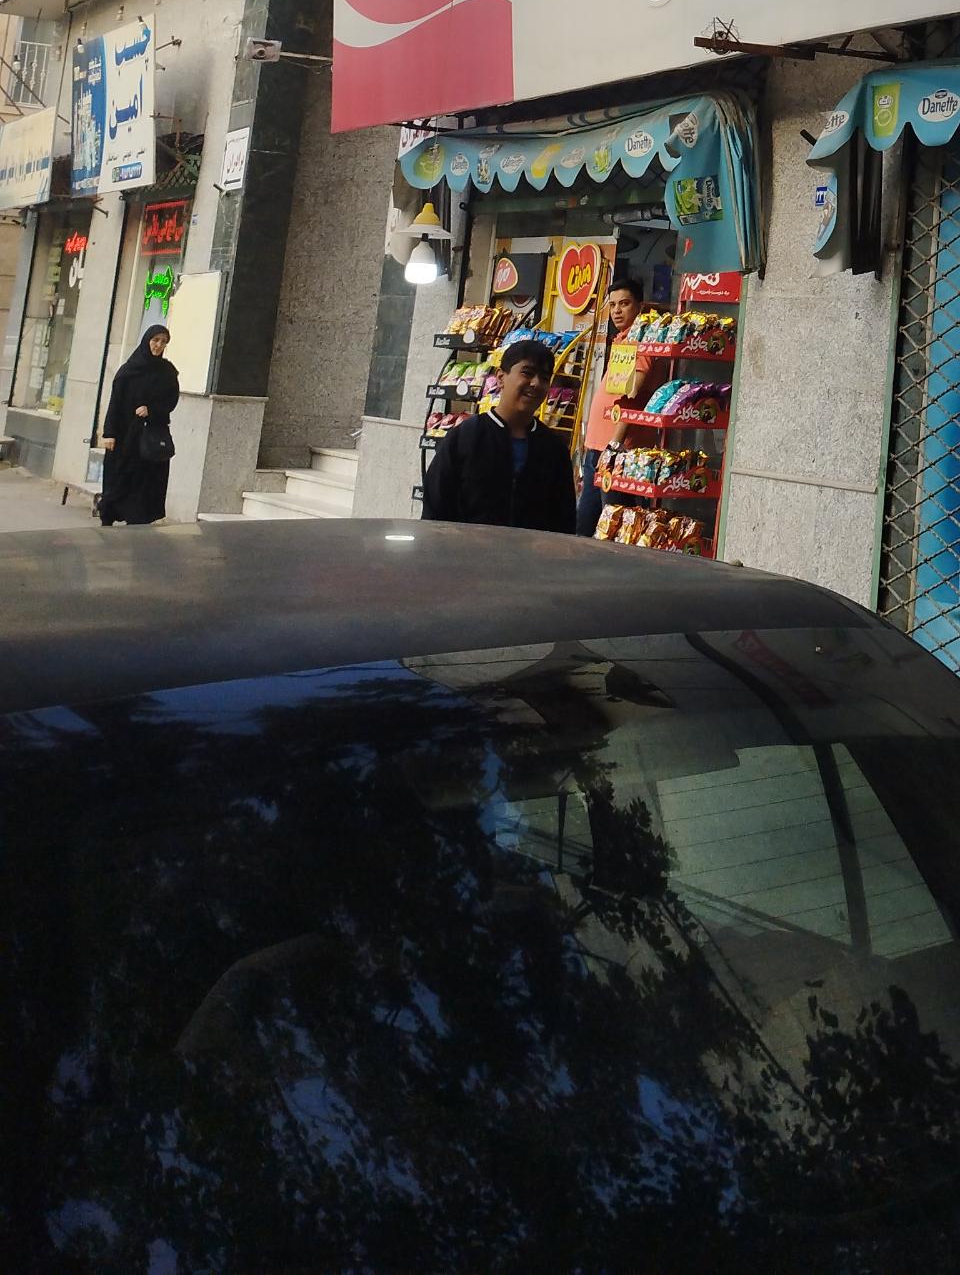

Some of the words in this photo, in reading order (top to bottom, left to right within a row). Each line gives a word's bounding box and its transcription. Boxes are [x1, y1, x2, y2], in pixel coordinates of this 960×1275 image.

[109, 73, 143, 141] امین
[921, 96, 959, 118] Danette
[824, 112, 846, 131] ette
[627, 136, 652, 152] Danette
[679, 122, 696, 144] ette
